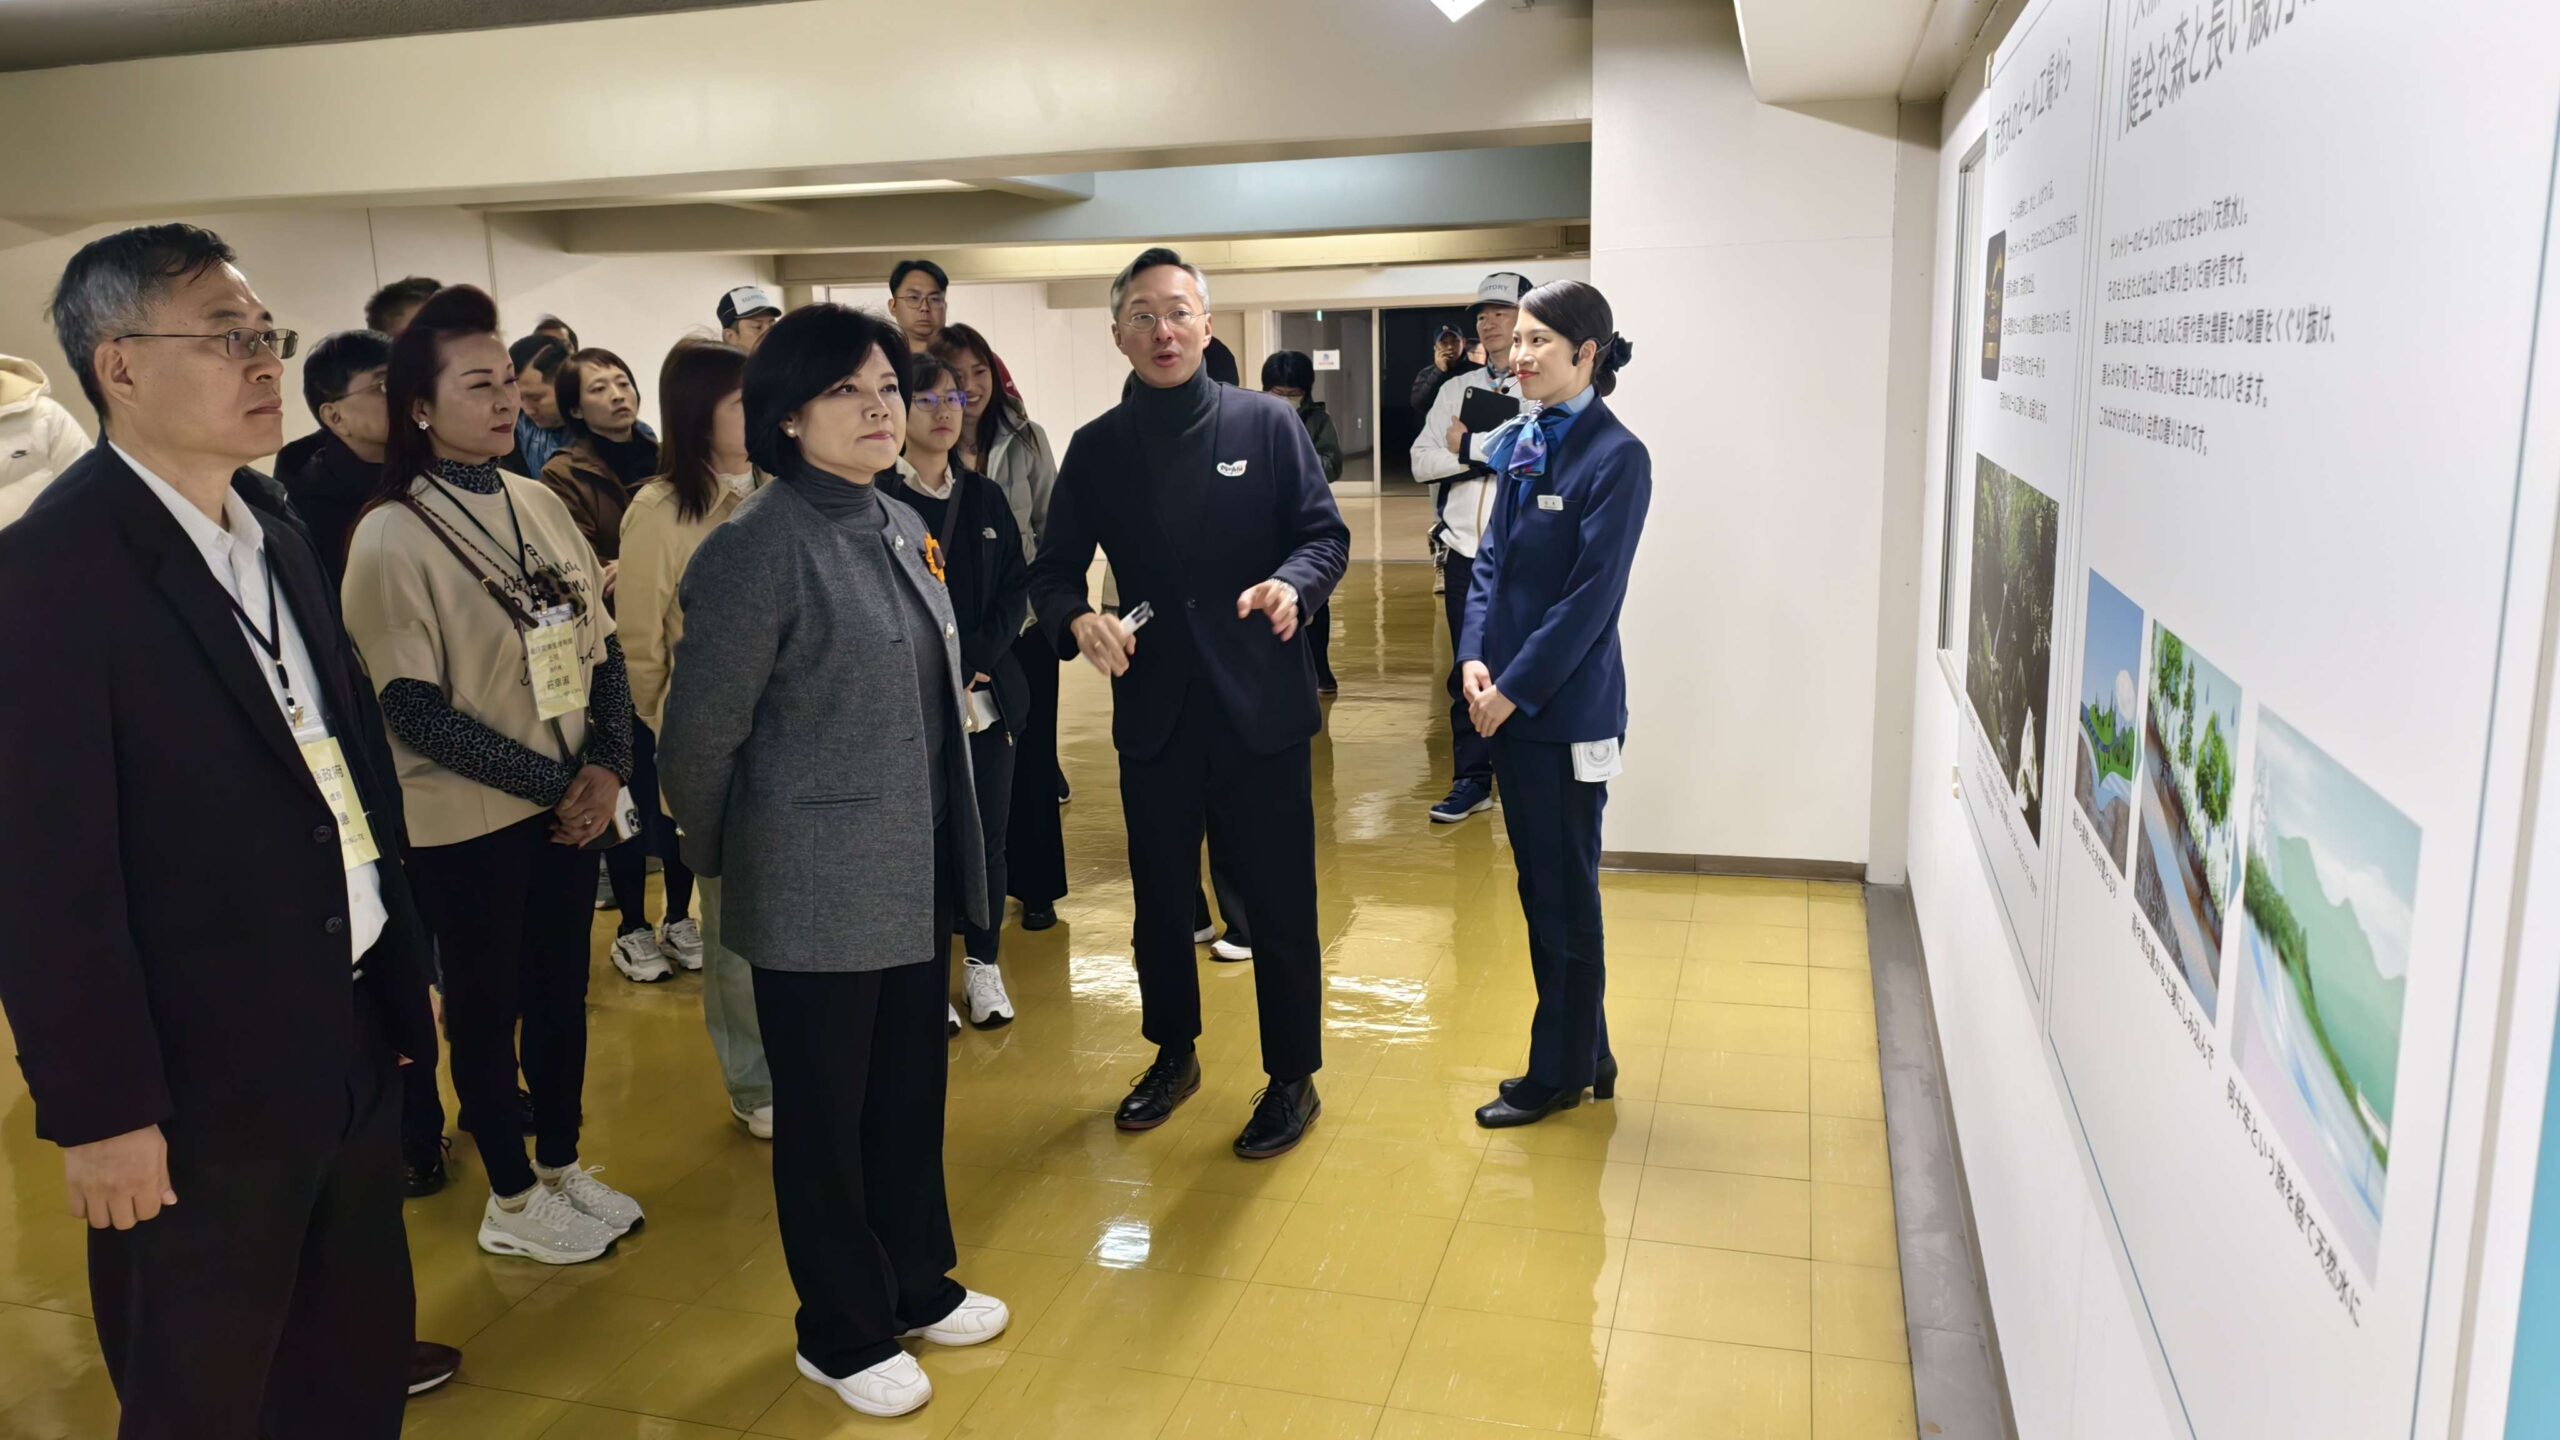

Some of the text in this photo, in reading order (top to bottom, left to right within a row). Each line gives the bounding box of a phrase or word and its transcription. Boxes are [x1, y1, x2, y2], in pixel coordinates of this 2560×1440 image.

[2226, 1076, 2361, 1328] 何十年という旅を経て天然水に
